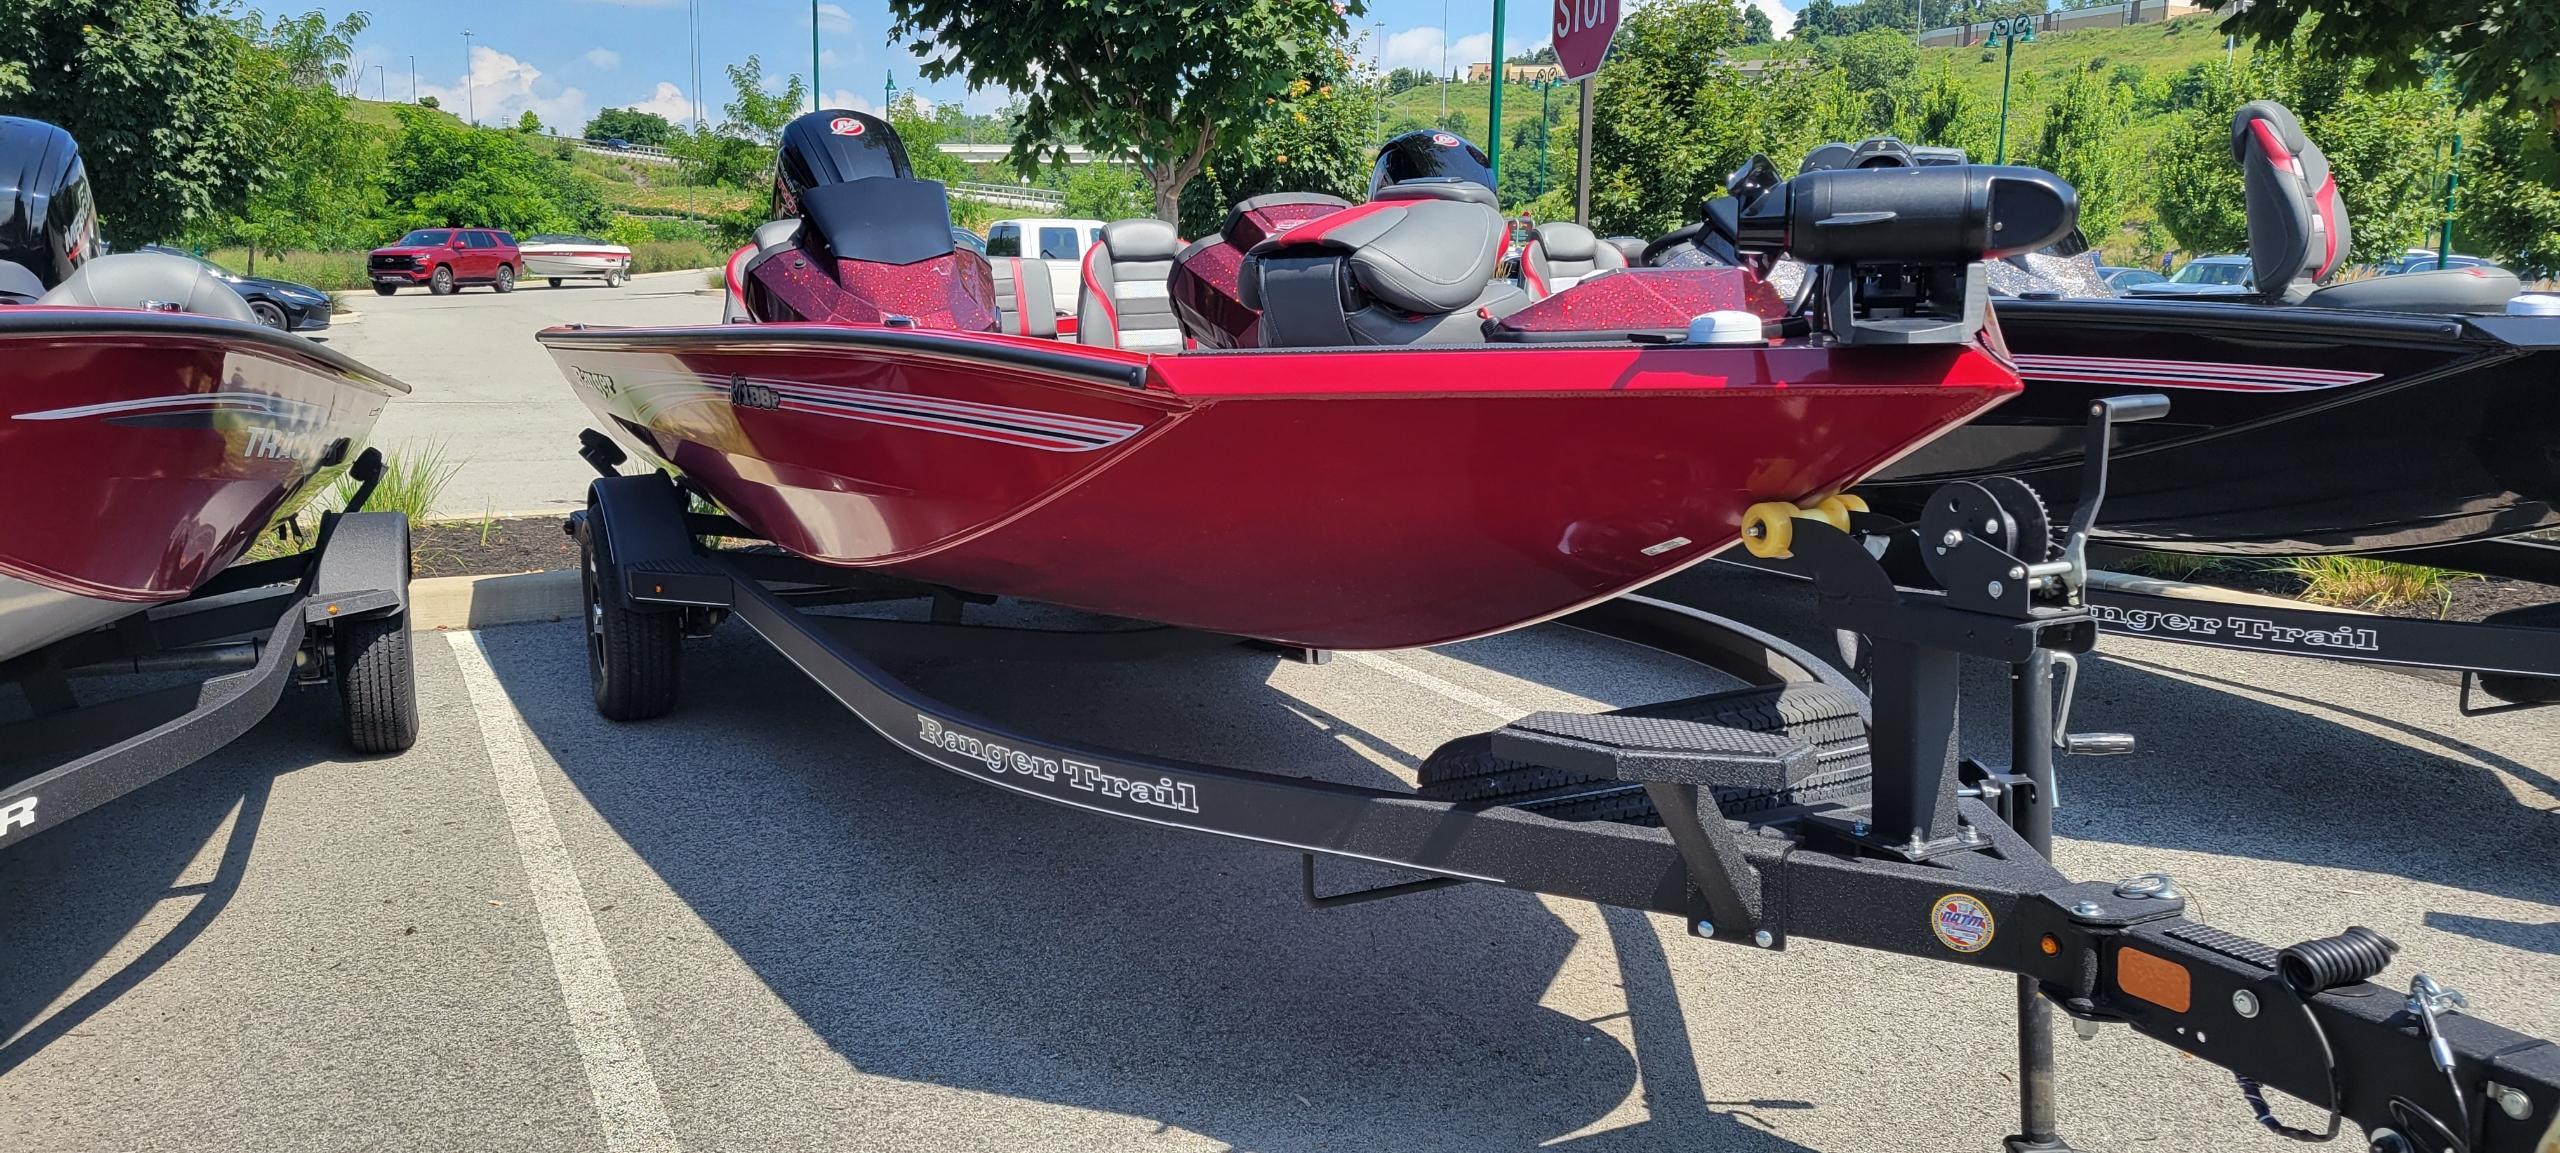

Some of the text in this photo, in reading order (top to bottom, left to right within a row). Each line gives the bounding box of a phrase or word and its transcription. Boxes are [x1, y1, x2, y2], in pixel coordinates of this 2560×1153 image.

[2090, 604, 2379, 651] nger Trail
[917, 713, 1199, 813] Ranger Trail
